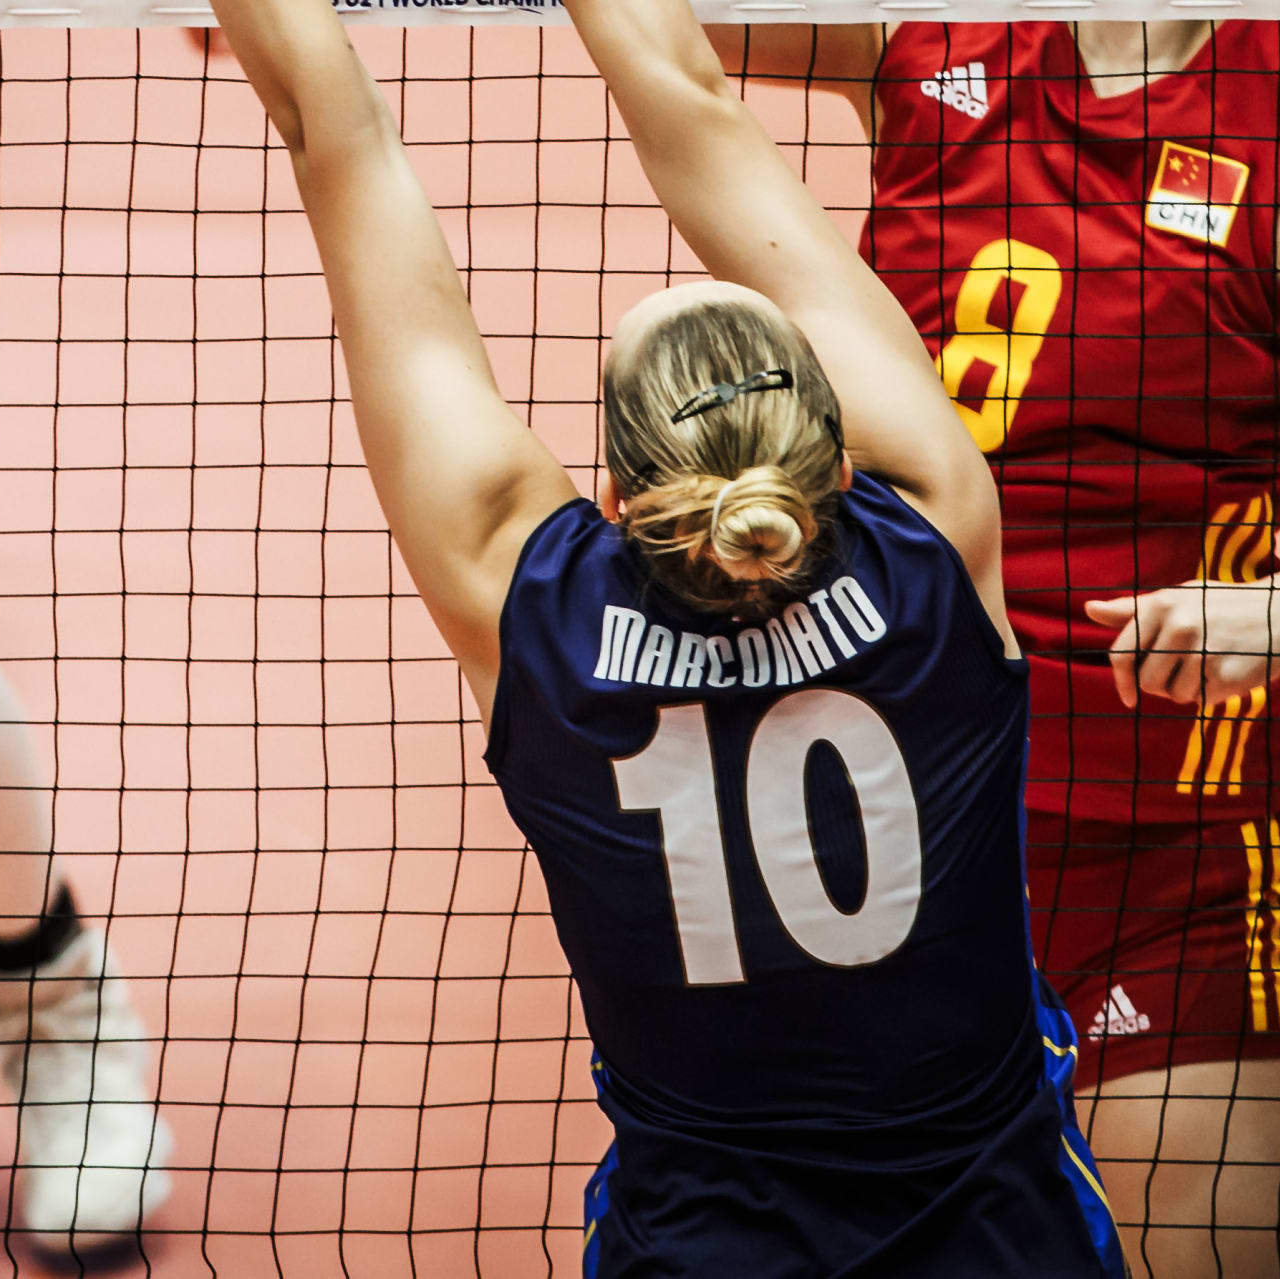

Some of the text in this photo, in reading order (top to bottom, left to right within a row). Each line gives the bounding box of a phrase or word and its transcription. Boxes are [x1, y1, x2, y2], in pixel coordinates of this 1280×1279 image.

[1158, 203, 1220, 232] CHN
[933, 238, 1063, 454] 8
[593, 575, 888, 688] MARCONATO
[610, 687, 923, 987] 10
